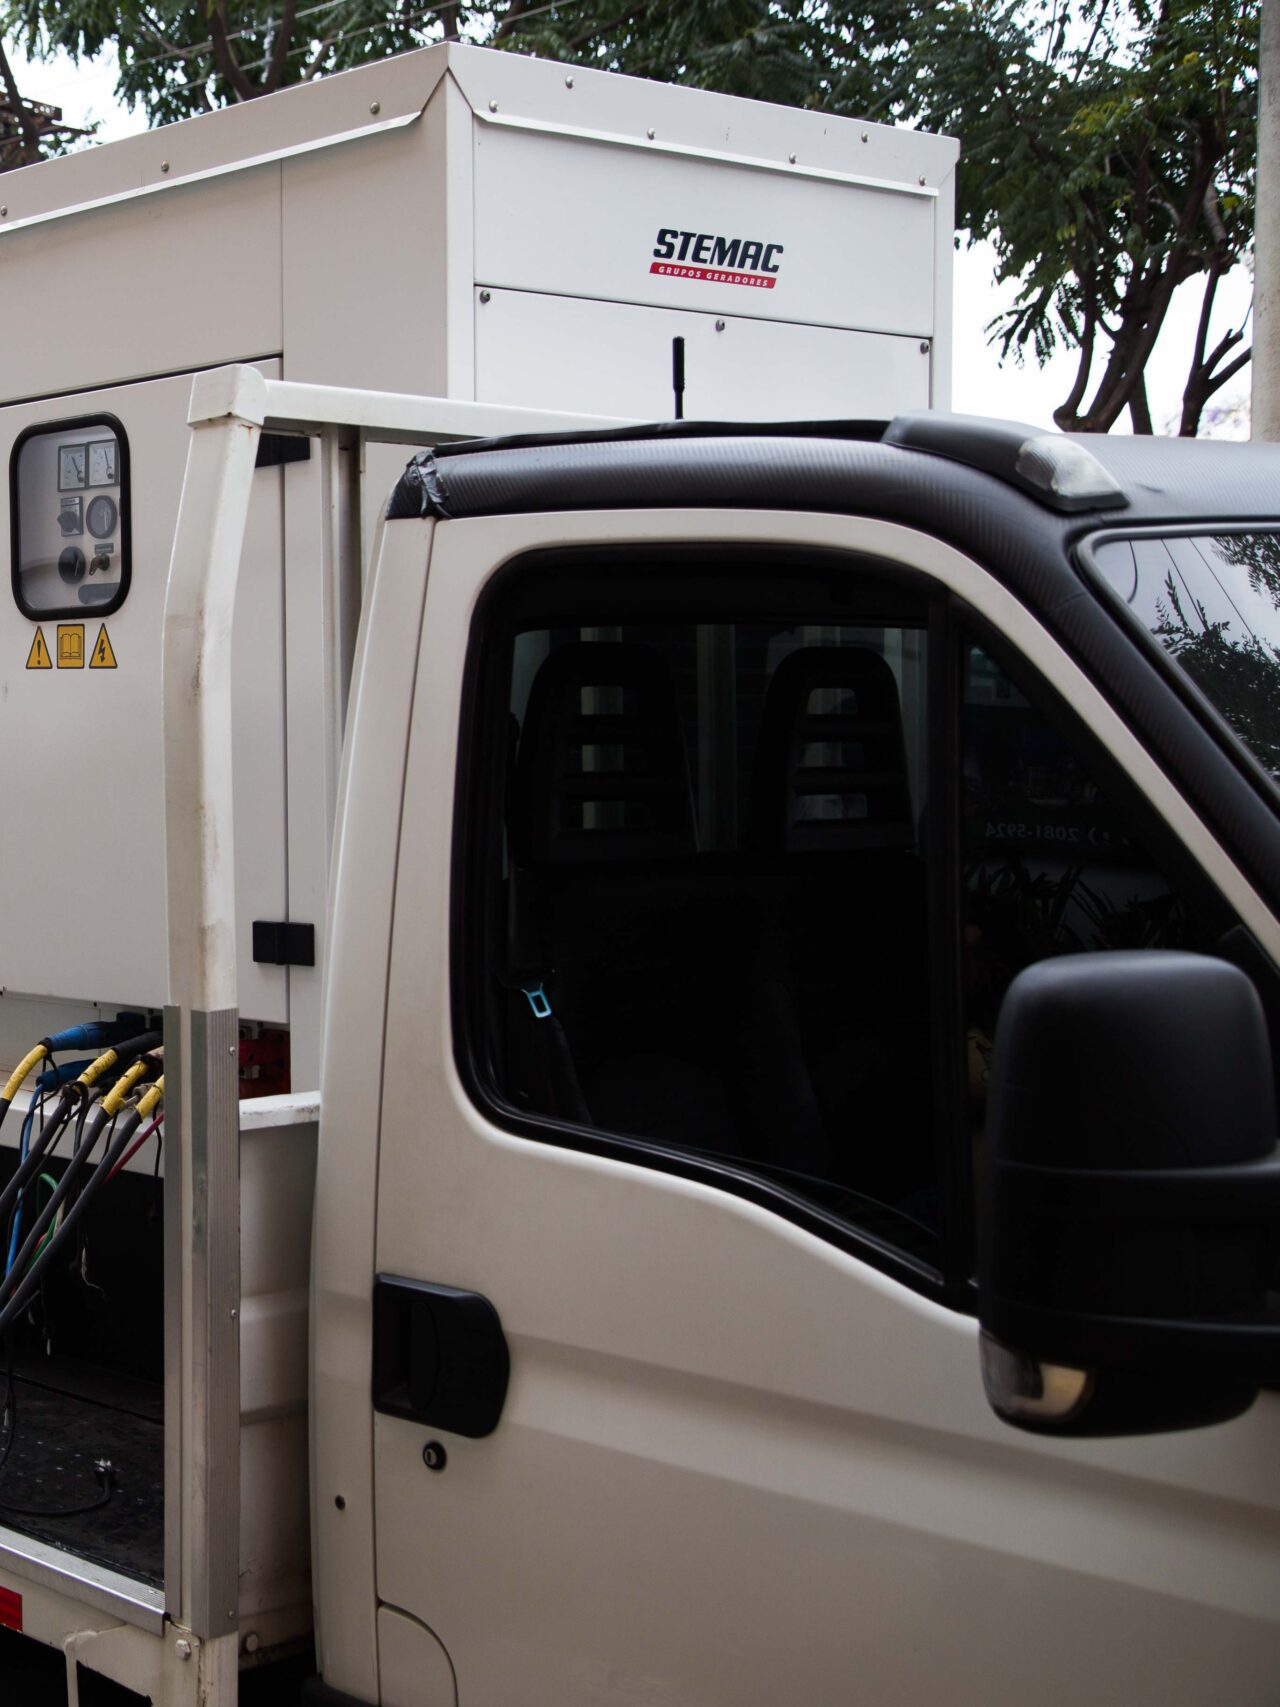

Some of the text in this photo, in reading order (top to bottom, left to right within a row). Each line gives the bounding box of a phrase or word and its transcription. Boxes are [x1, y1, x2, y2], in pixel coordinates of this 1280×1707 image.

[652, 228, 784, 273] STEMAC
[658, 265, 769, 287] GRUPOS GERADORES
